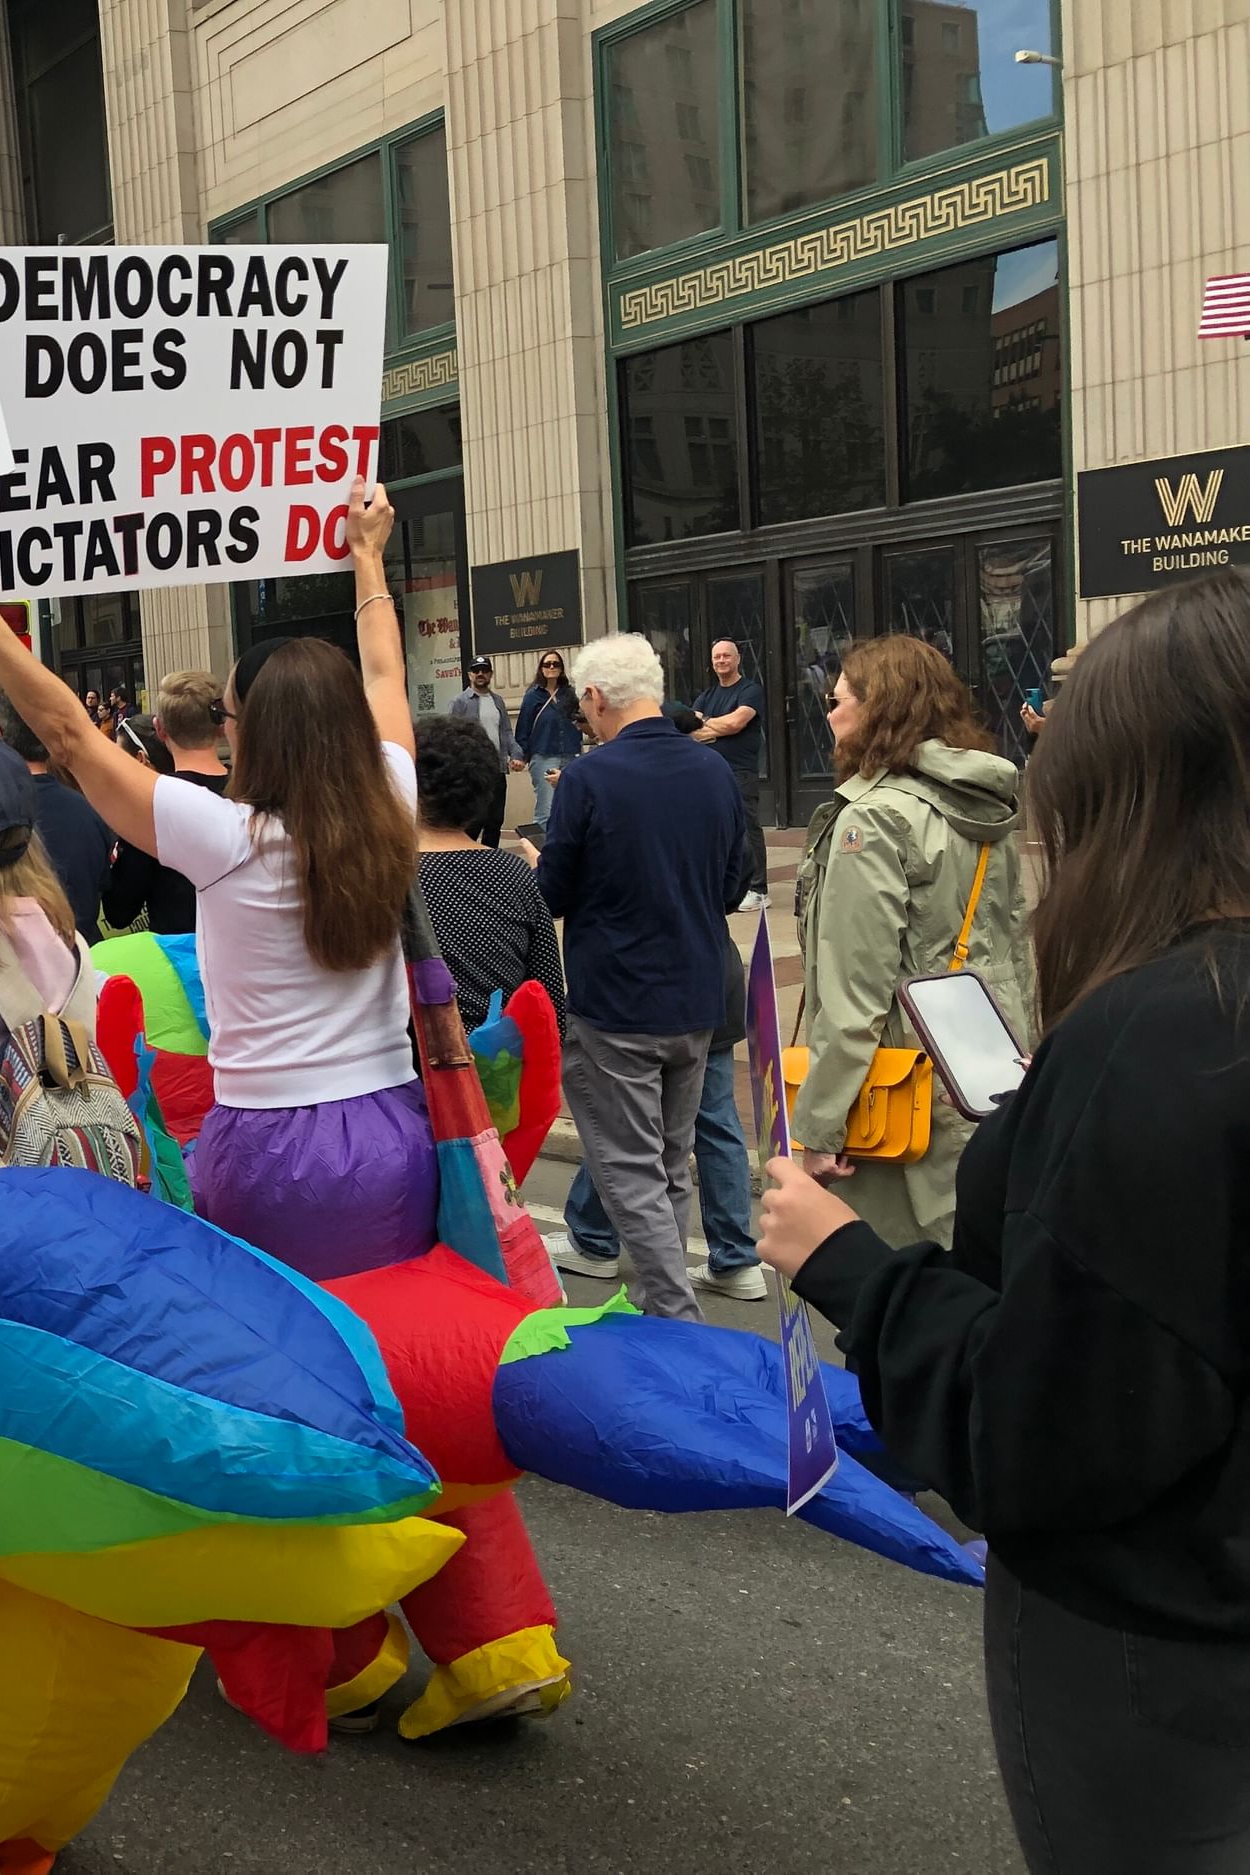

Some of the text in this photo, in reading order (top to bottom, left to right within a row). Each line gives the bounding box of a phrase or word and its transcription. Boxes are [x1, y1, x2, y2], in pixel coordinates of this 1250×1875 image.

[25, 328, 343, 399] DOES NOT
[140, 424, 379, 498] PROTEST
[284, 504, 350, 562] DO
[1121, 526, 1250, 554] THE WANAMAKE
[1153, 549, 1229, 571] BUILDING
[494, 615, 510, 625] THE
